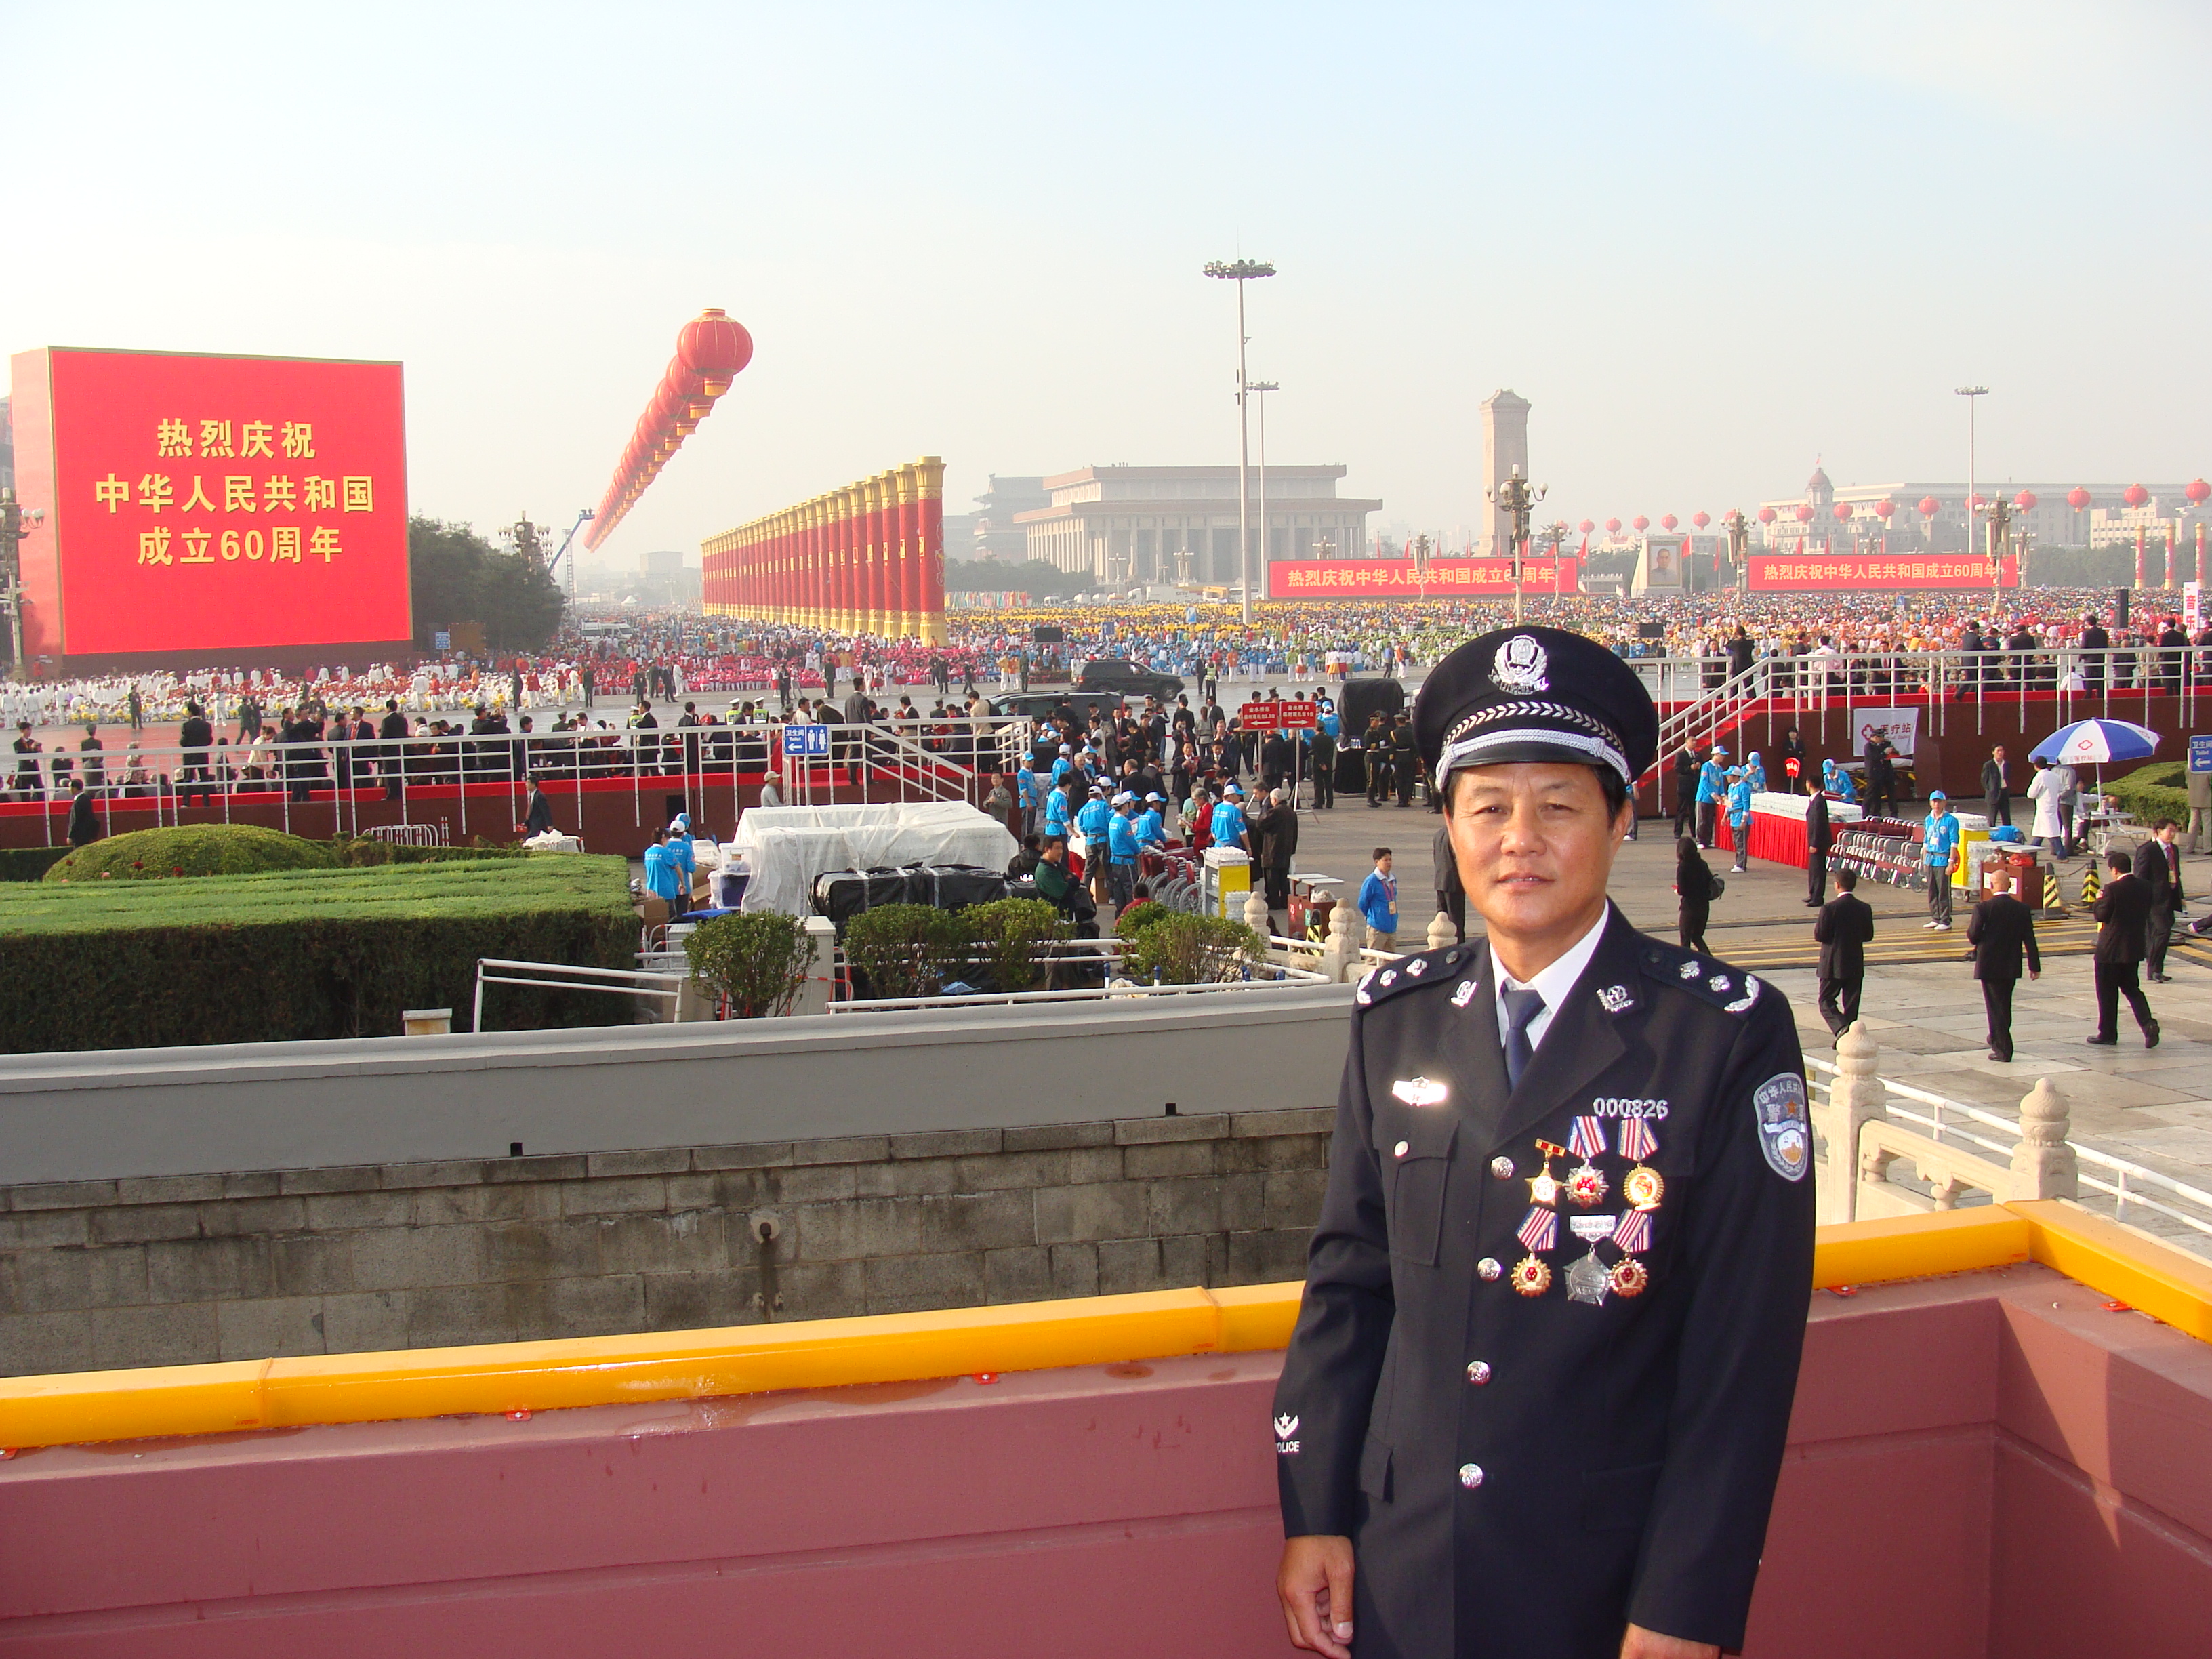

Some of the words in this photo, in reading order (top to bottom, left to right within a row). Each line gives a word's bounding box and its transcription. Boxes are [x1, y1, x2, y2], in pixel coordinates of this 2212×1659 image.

[157, 418, 316, 459] 热烈庆祝
[96, 473, 375, 514] 中华人民共和国
[137, 525, 344, 567] 成立60周年
[1288, 567, 1555, 587] 热烈庆祝中华人民共和国成立6周年
[1763, 562, 1998, 581] 热烈庆祝中华人民共和国成立60周年
[1880, 723, 1911, 734] 医疗站
[1593, 1097, 1669, 1120] 000826
[1275, 1441, 1300, 1453] OLICE
